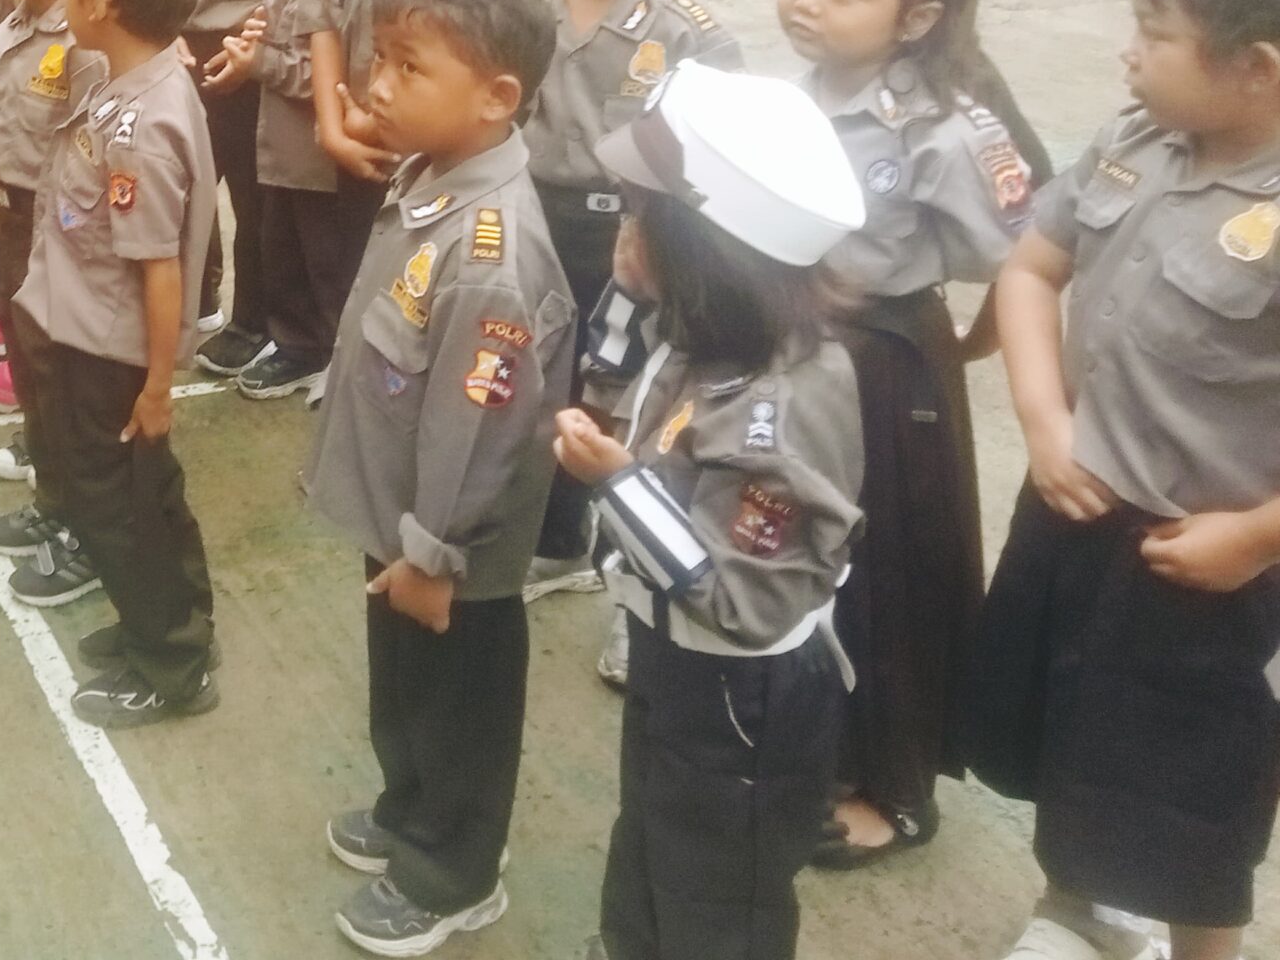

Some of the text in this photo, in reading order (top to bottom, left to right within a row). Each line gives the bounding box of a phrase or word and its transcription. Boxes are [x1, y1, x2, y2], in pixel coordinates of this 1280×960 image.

[473, 249, 500, 259] POLRI
[485, 322, 528, 346] POLRI
[747, 485, 793, 515] POLRI
